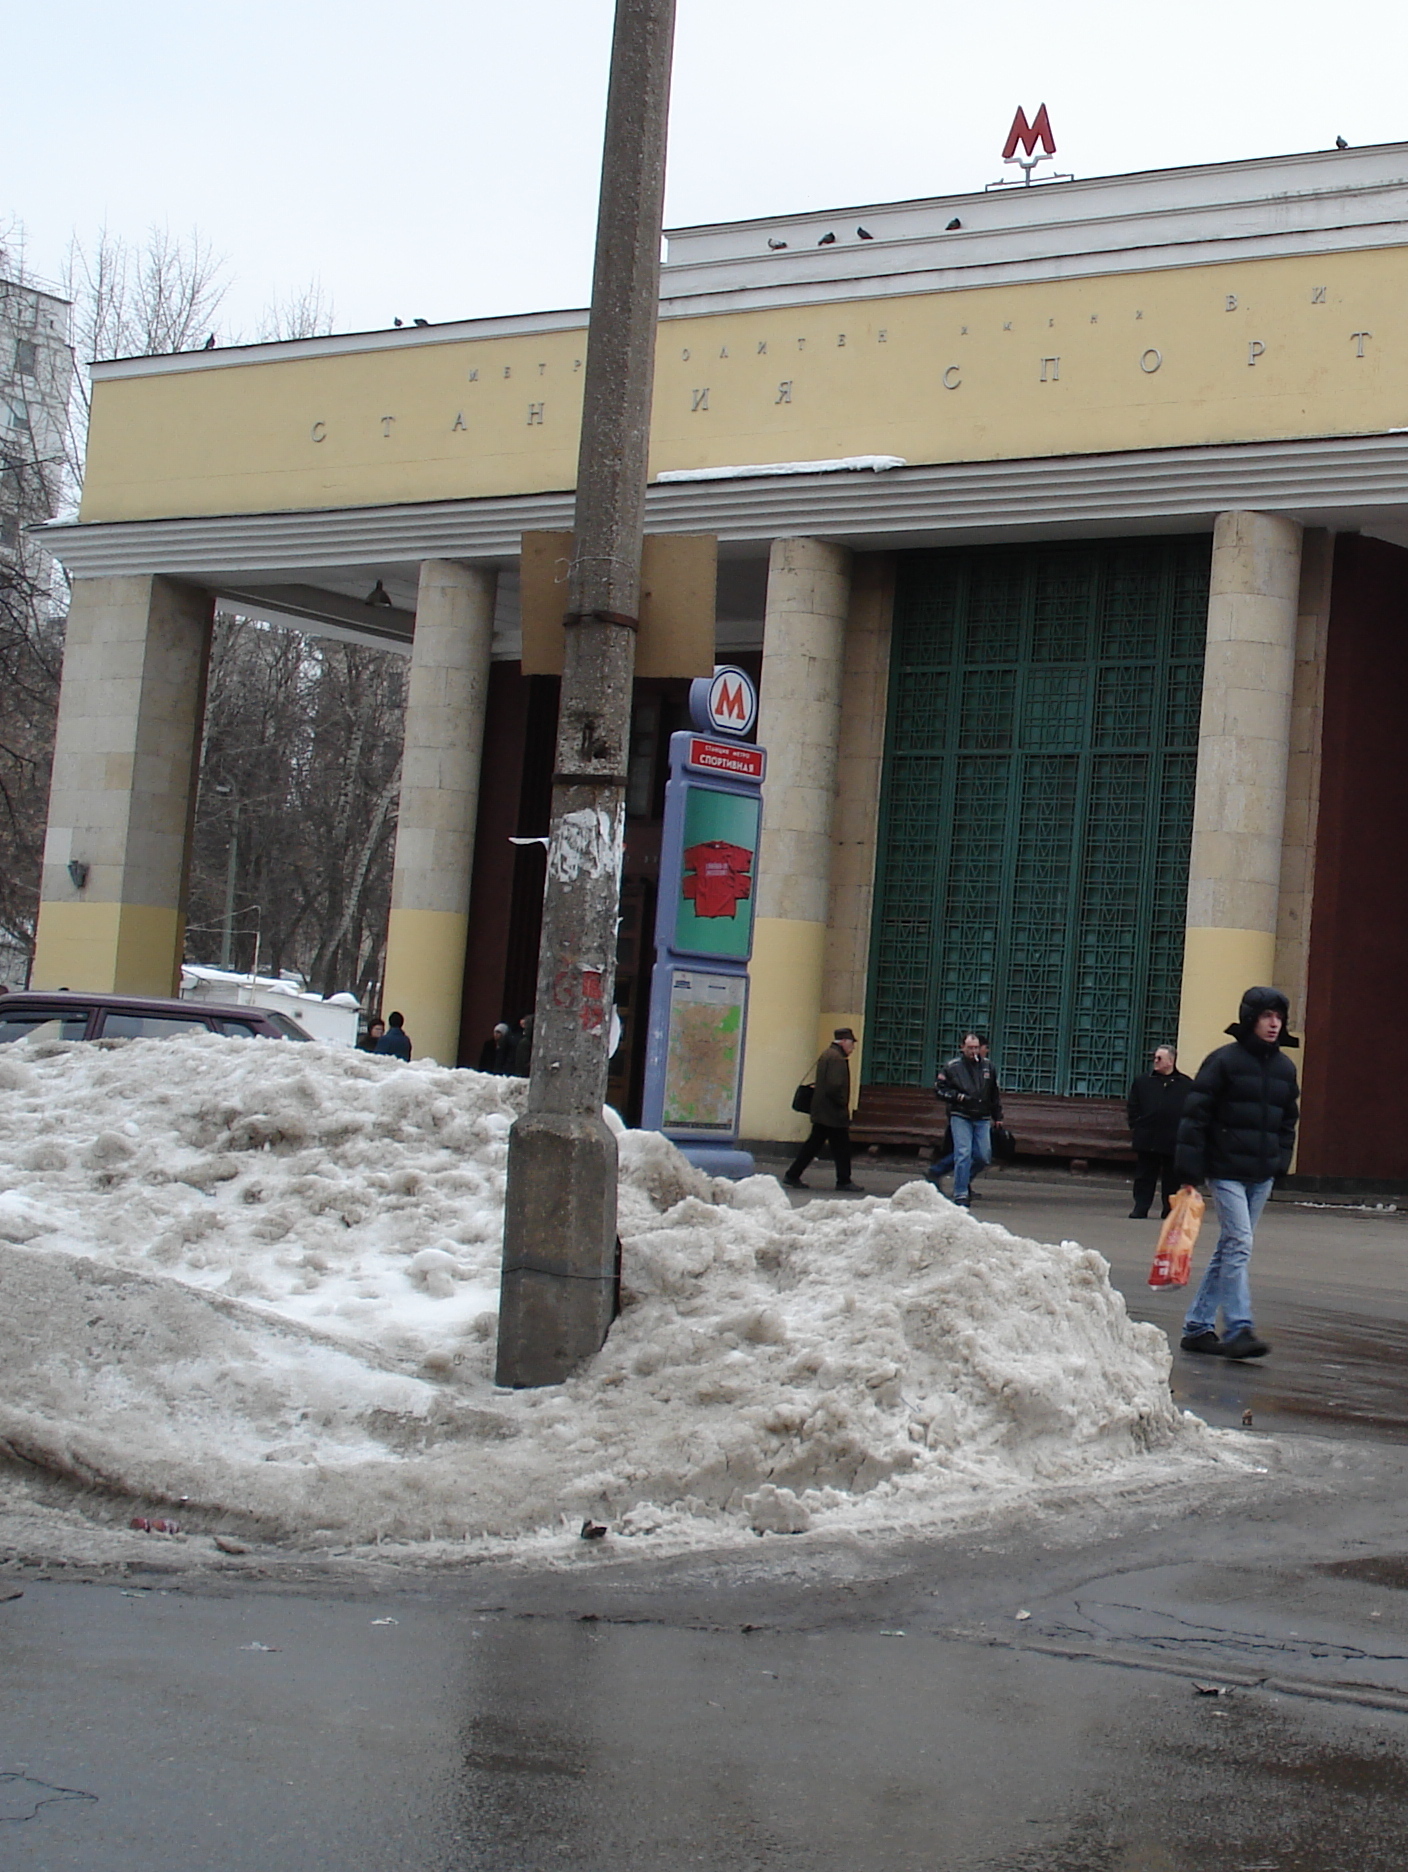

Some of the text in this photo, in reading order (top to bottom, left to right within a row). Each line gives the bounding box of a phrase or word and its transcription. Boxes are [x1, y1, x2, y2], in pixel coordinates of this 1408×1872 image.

[1001, 102, 1056, 158] М
[469, 329, 888, 382] МЕТРОЛИТЕН
[310, 380, 794, 444] СТАНИЯ
[714, 678, 747, 721] М
[699, 754, 755, 773] СПОРТИВНАЯ
